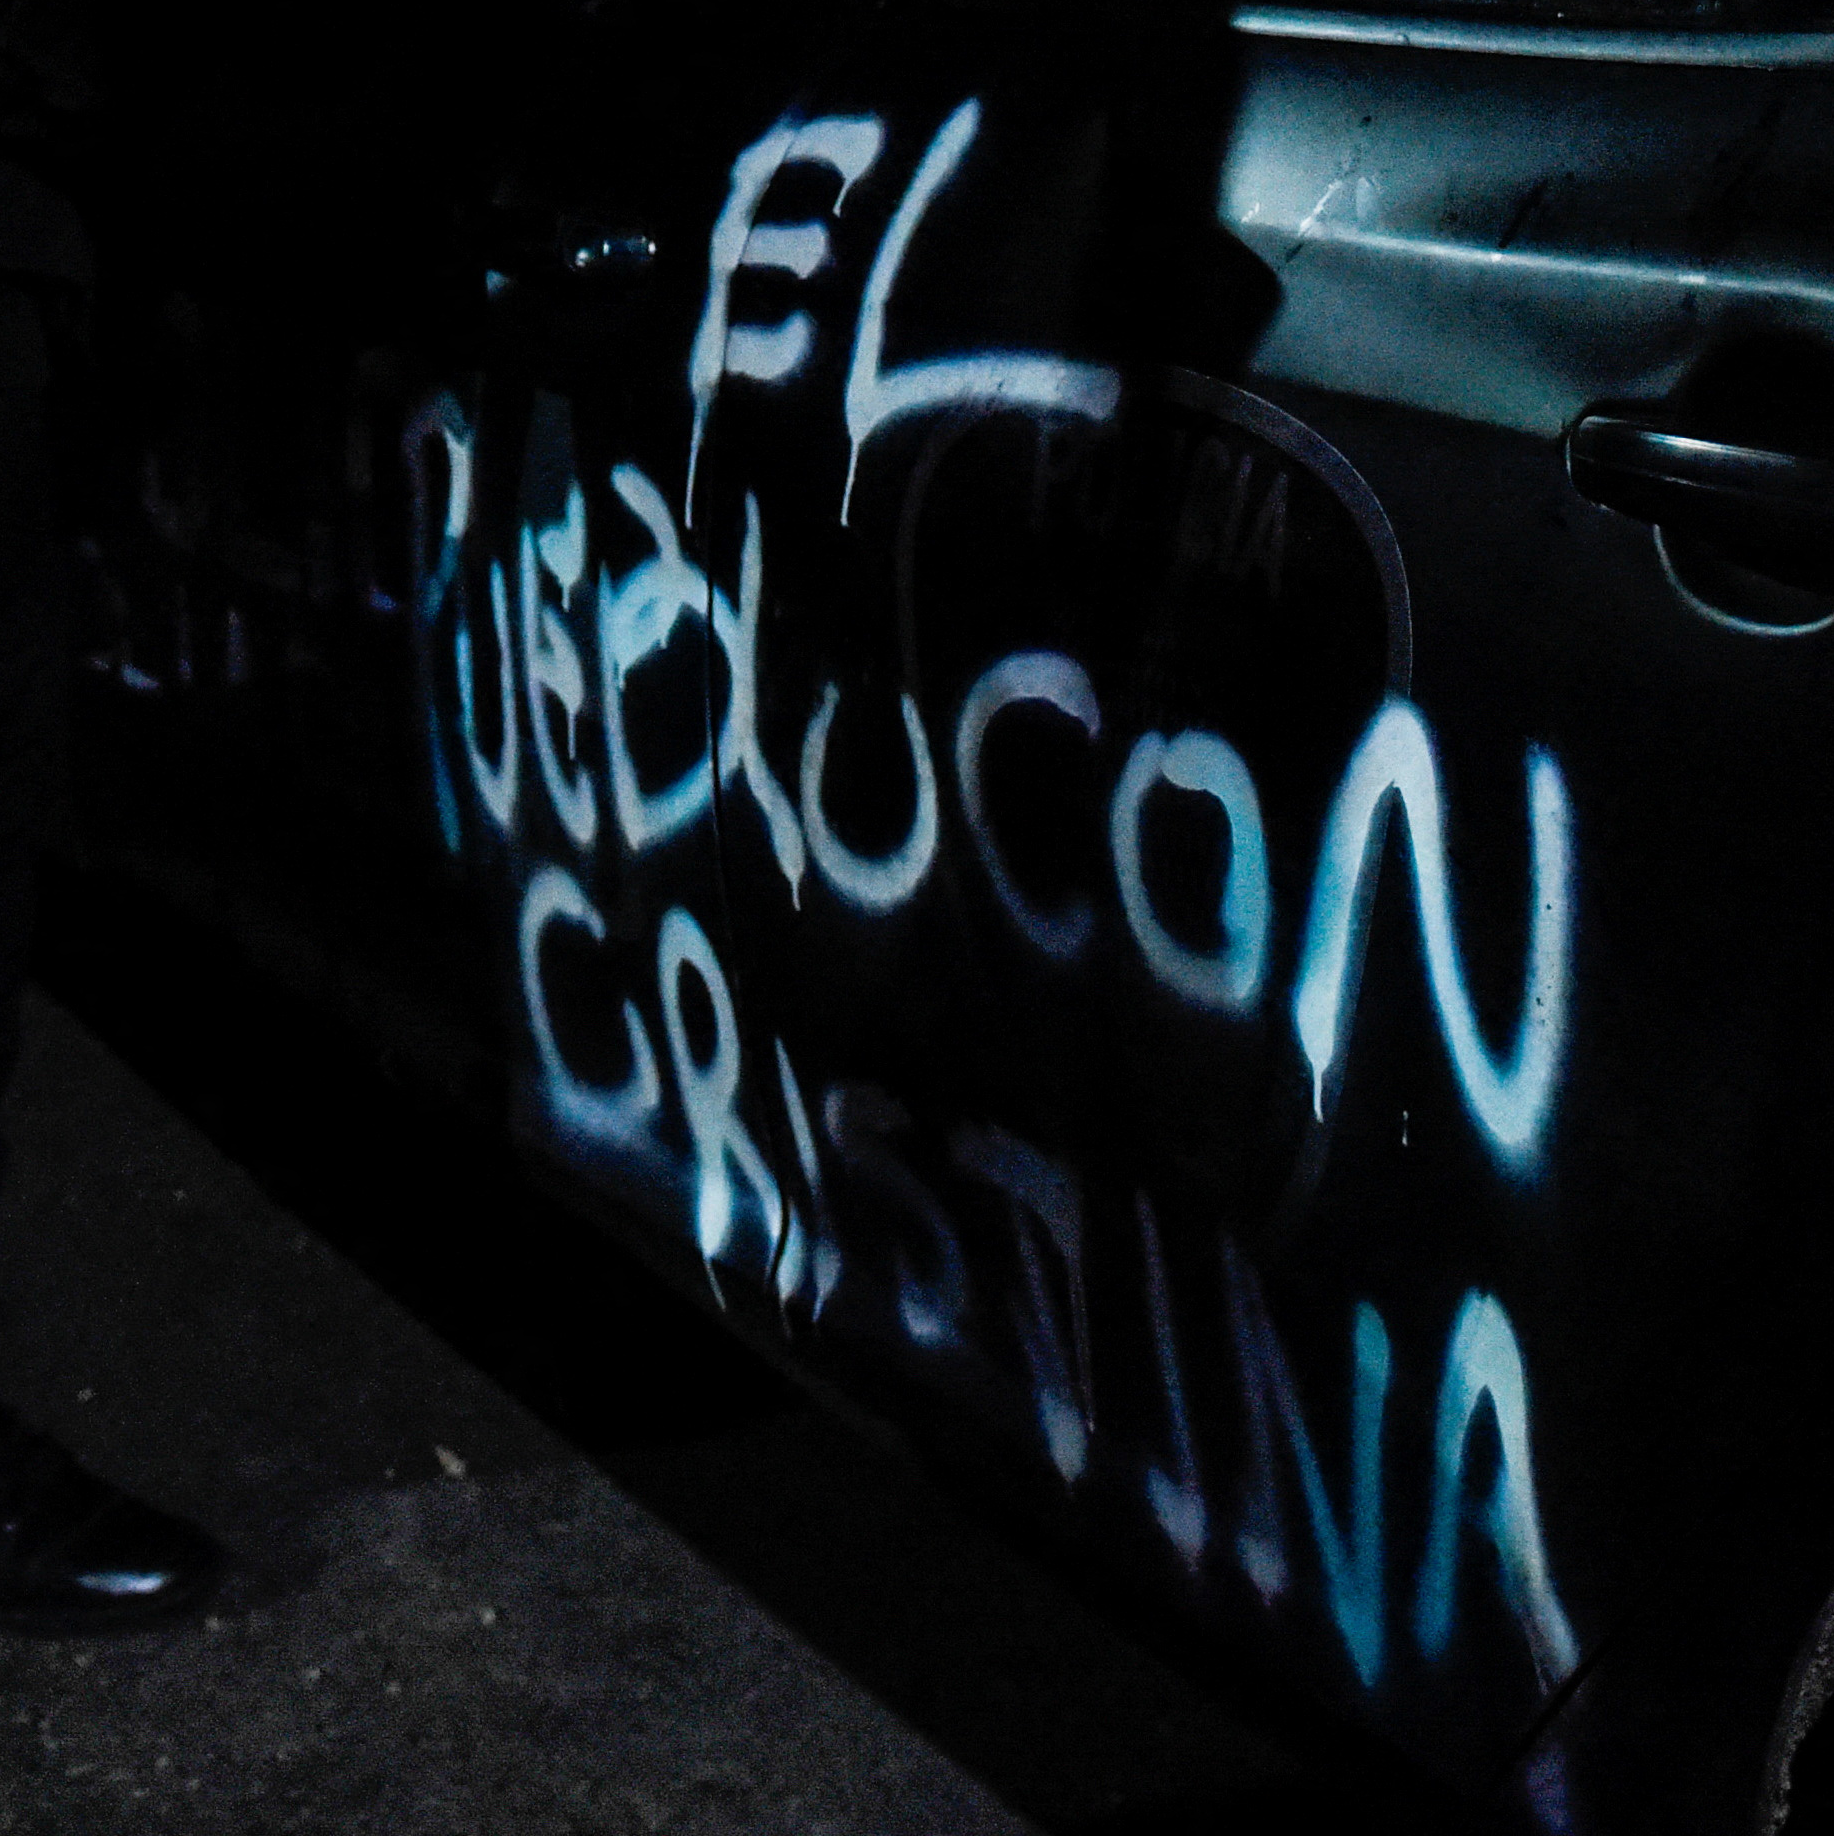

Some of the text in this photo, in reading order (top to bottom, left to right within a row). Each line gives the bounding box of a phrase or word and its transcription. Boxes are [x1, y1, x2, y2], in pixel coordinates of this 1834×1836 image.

[693, 96, 1121, 454] EL
[954, 648, 1577, 1188] CON
[512, 864, 1582, 1714] CRISTINA
